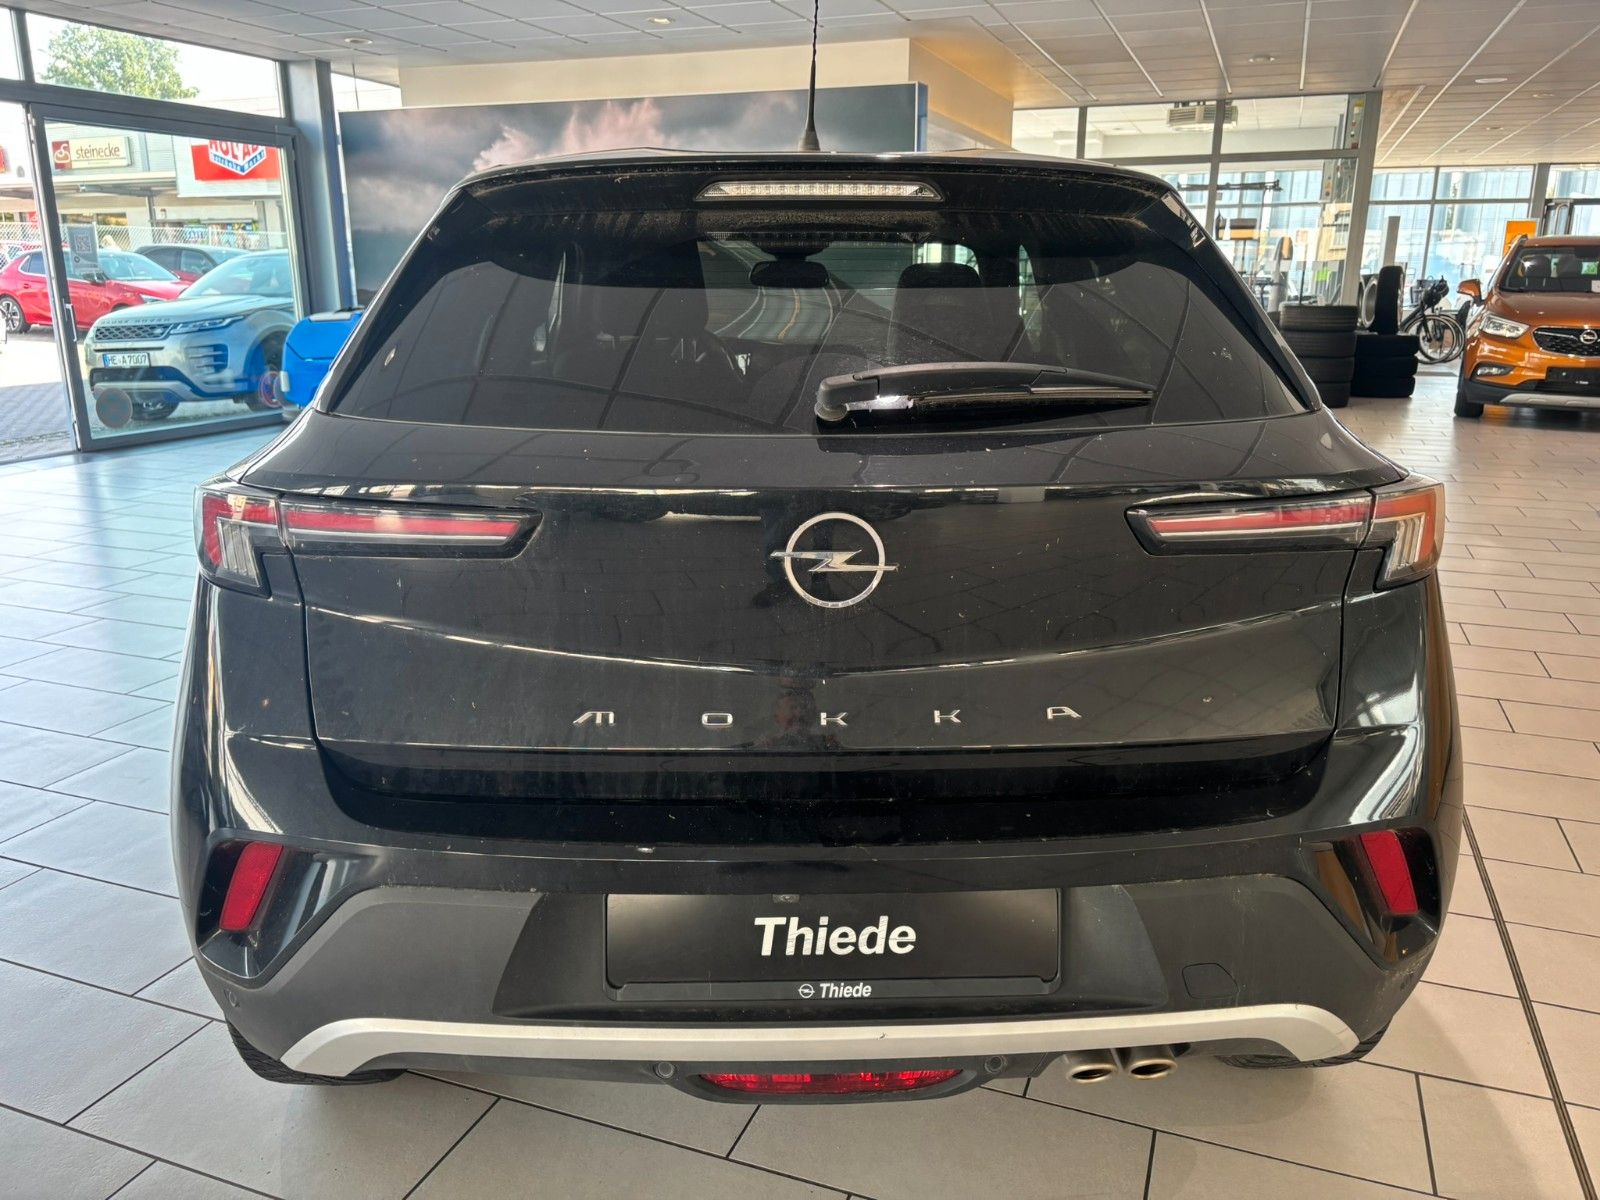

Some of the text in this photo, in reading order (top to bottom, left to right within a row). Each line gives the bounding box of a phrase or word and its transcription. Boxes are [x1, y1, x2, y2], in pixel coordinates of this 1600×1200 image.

[75, 142, 121, 159] steinecke
[572, 705, 1082, 727] MOKKA
[754, 915, 917, 956] Thiede
[819, 982, 872, 999] Thiede
